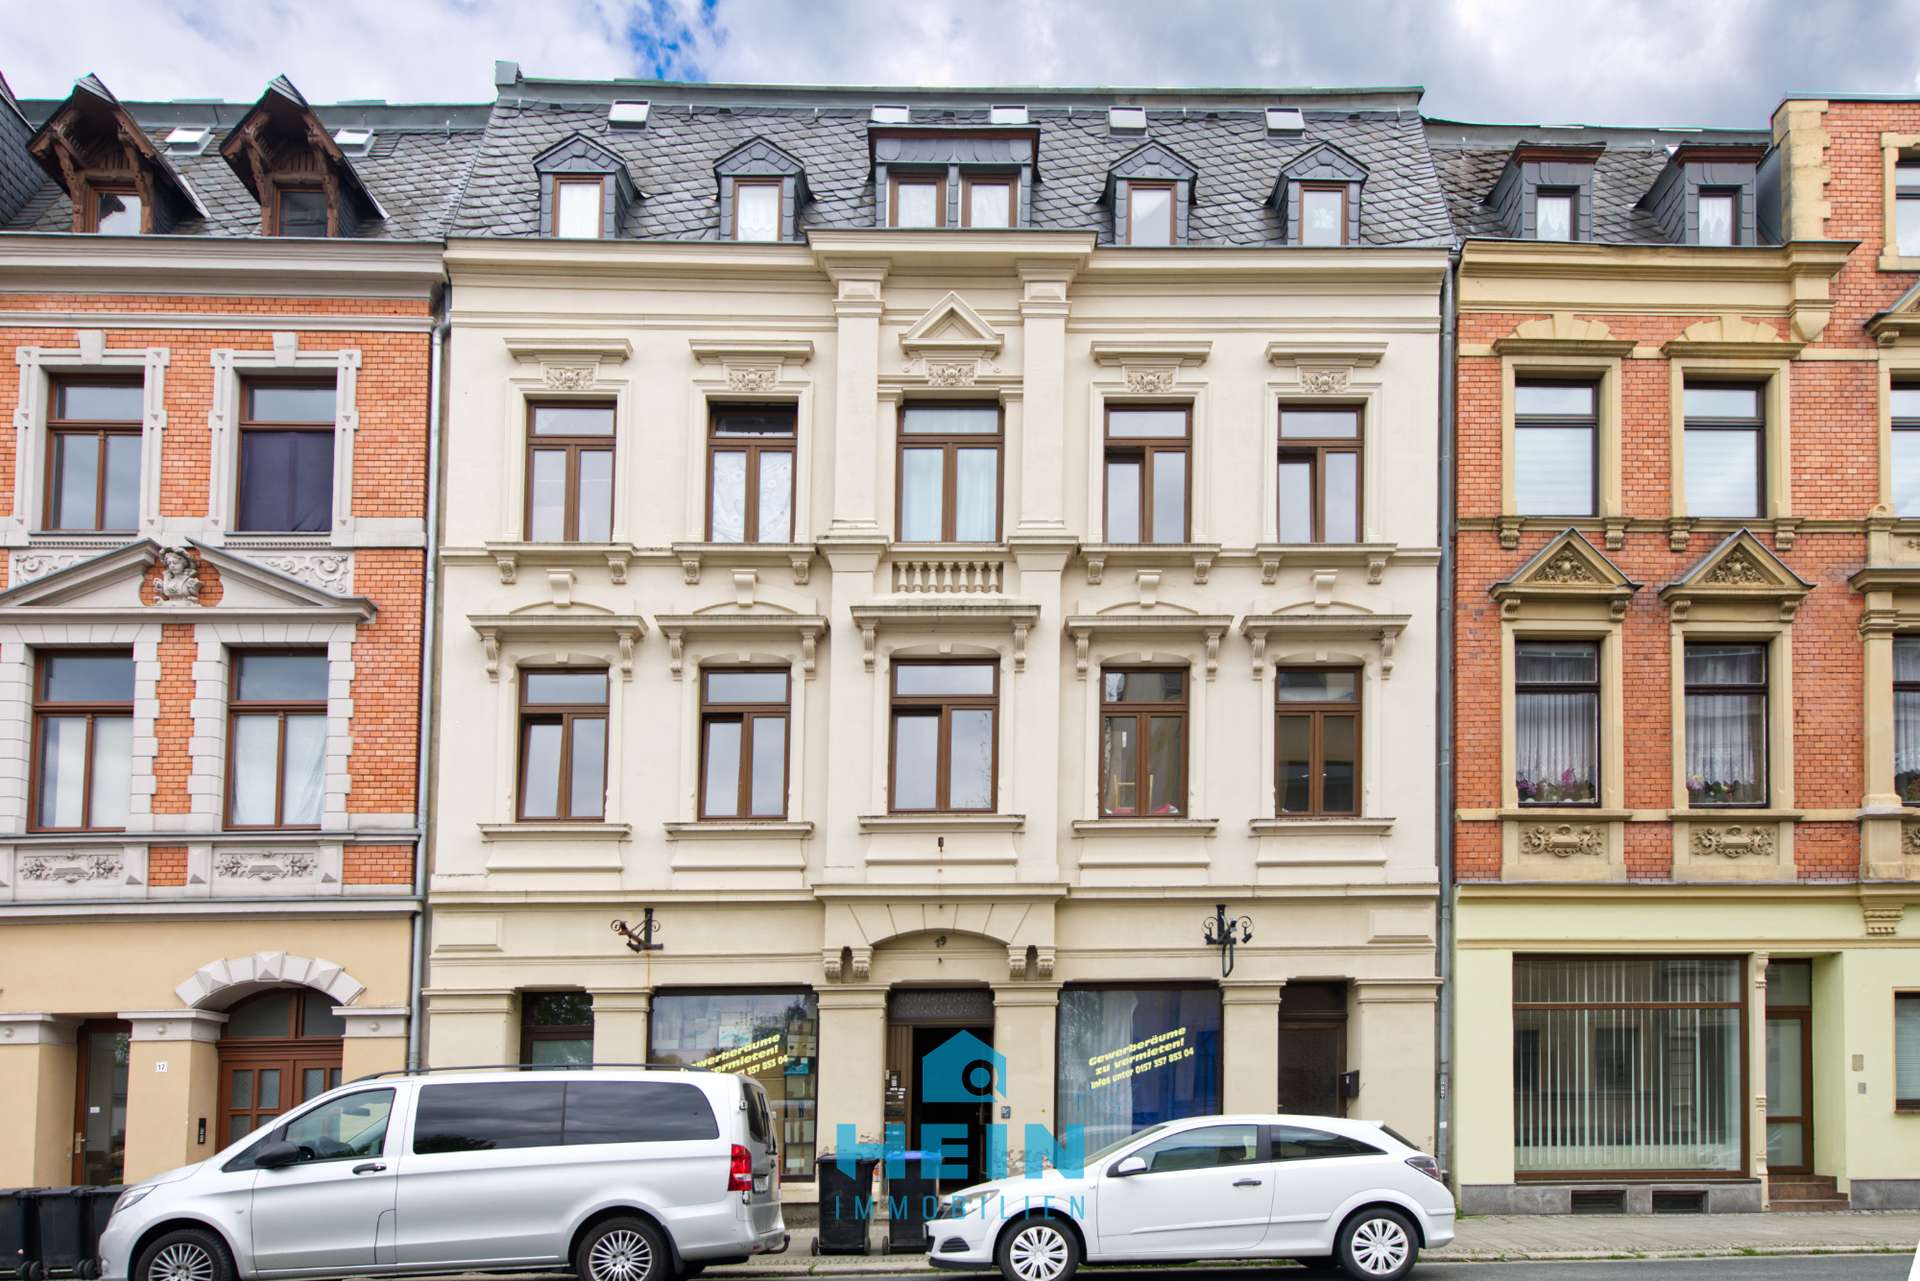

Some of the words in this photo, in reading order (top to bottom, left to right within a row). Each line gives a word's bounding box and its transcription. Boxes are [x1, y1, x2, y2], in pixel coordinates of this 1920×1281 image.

[711, 1044, 779, 1073] ermieten!
[1088, 1026, 1187, 1066] Gewerberäume
[1095, 1064, 1111, 1076] zu
[1113, 1037, 1185, 1069] vermieten!
[1090, 1076, 1111, 1090] Infos
[1112, 1068, 1134, 1082] unter
[1135, 1061, 1152, 1074] 0157
